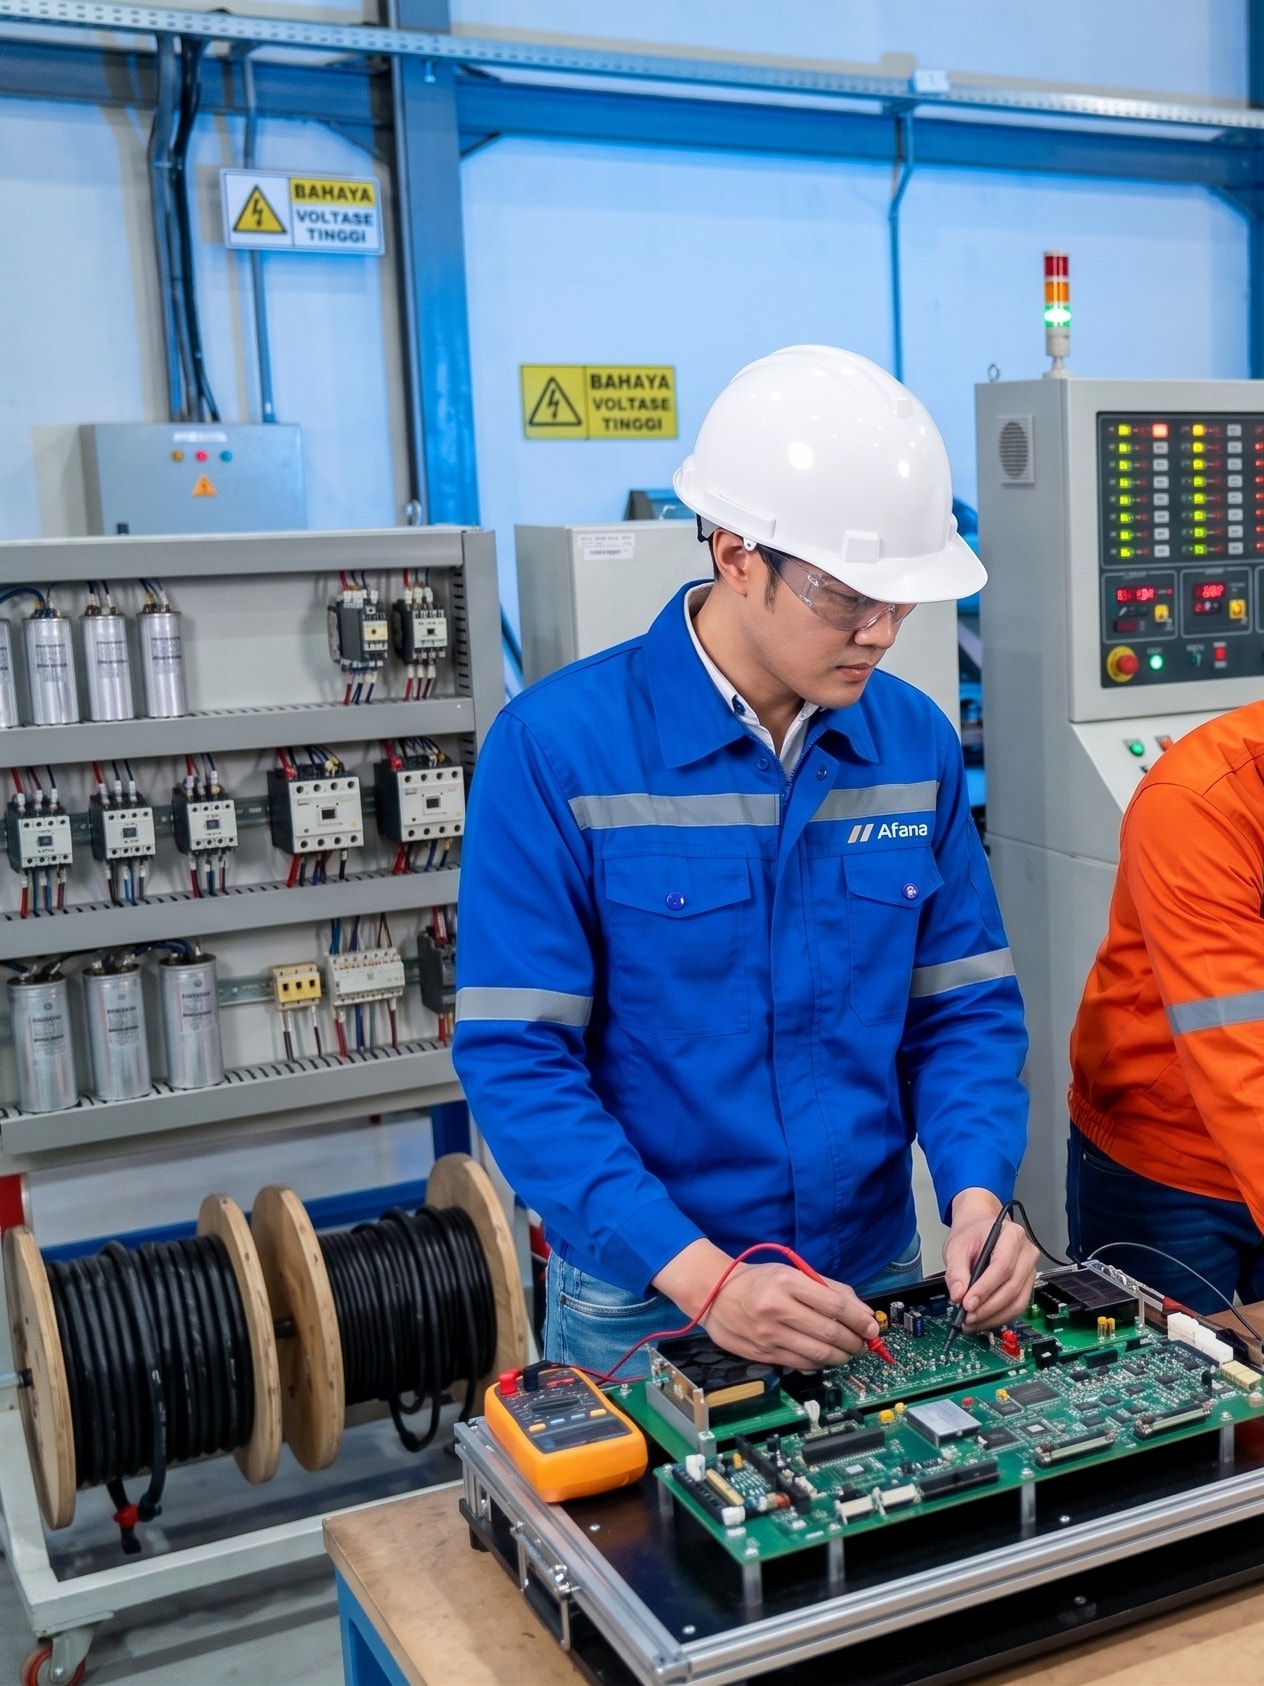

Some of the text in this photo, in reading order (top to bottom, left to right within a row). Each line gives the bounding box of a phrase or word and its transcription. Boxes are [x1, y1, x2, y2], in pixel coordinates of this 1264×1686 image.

[294, 183, 373, 203] BAHAYA
[296, 209, 374, 227] VOLTASE
[306, 227, 367, 244] TINGGI
[590, 373, 671, 390] BAHAYA
[592, 397, 671, 412] VOLTASE
[602, 417, 663, 432] TINGGI
[877, 822, 928, 840] Afana
